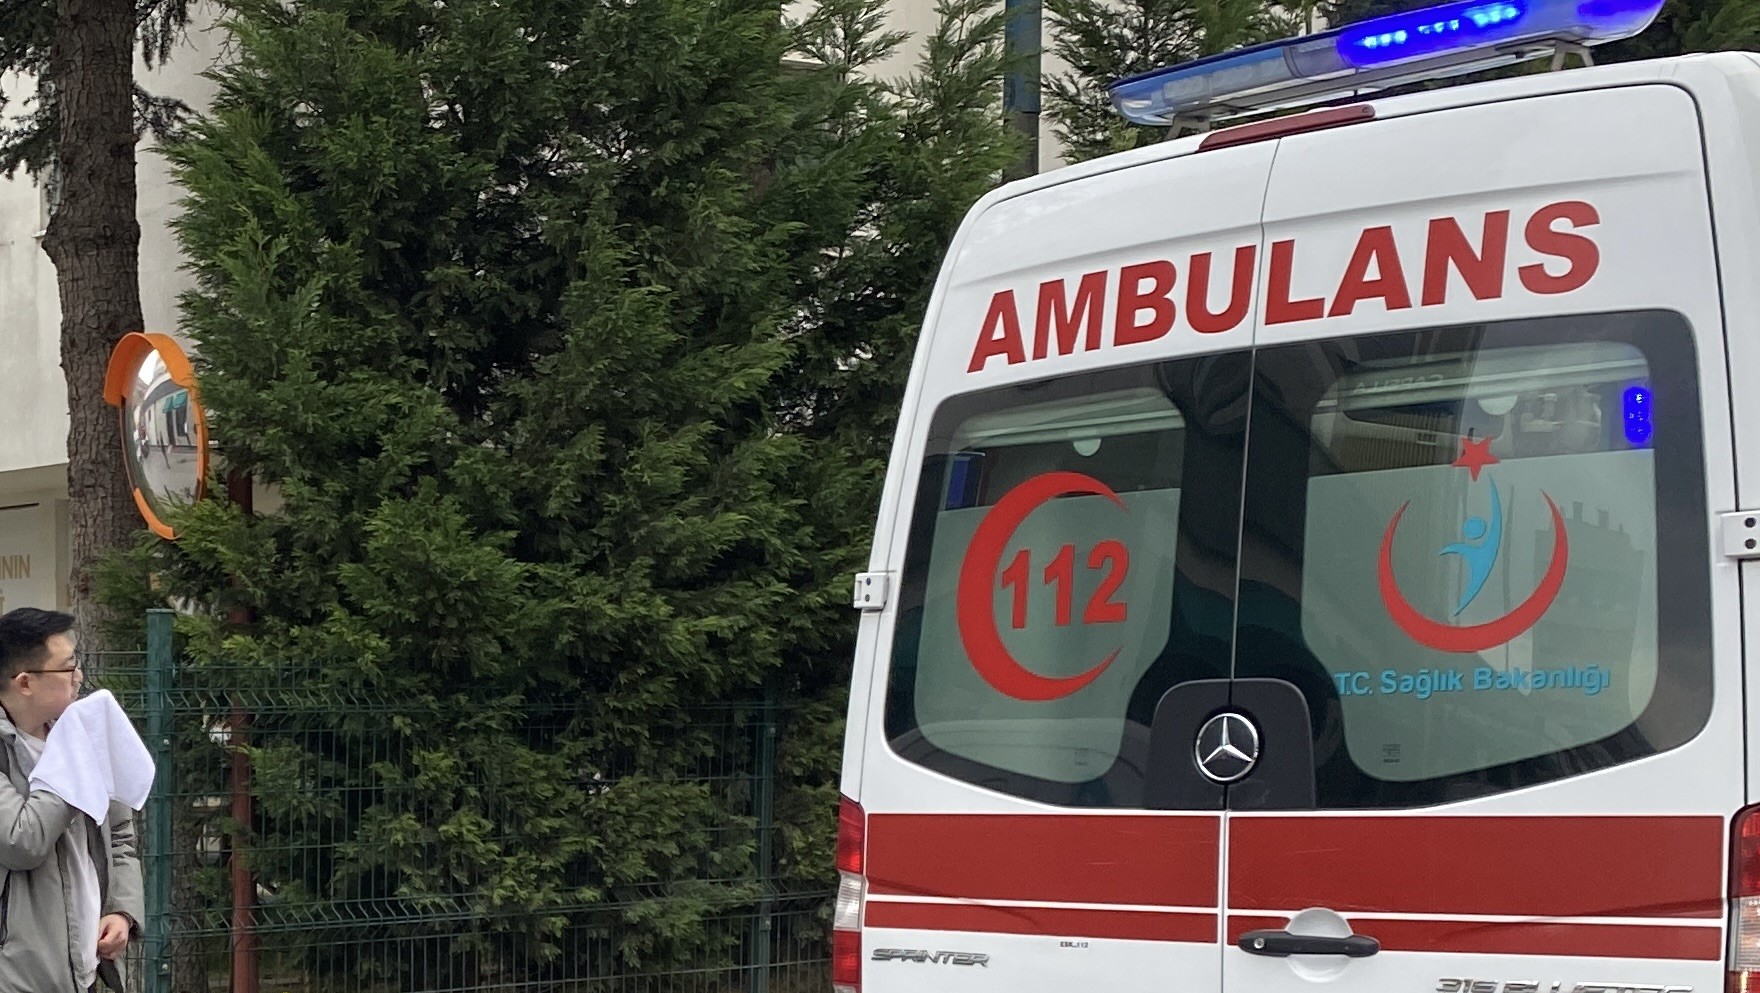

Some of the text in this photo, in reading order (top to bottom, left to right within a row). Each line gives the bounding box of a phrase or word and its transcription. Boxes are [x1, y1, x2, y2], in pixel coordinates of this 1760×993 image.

[966, 200, 1602, 374] AMBULANS
[1000, 539, 1130, 630] 112
[1334, 664, 1611, 699] T.C. Sağlık Bakanlığı
[871, 948, 991, 968] SPRINTER
